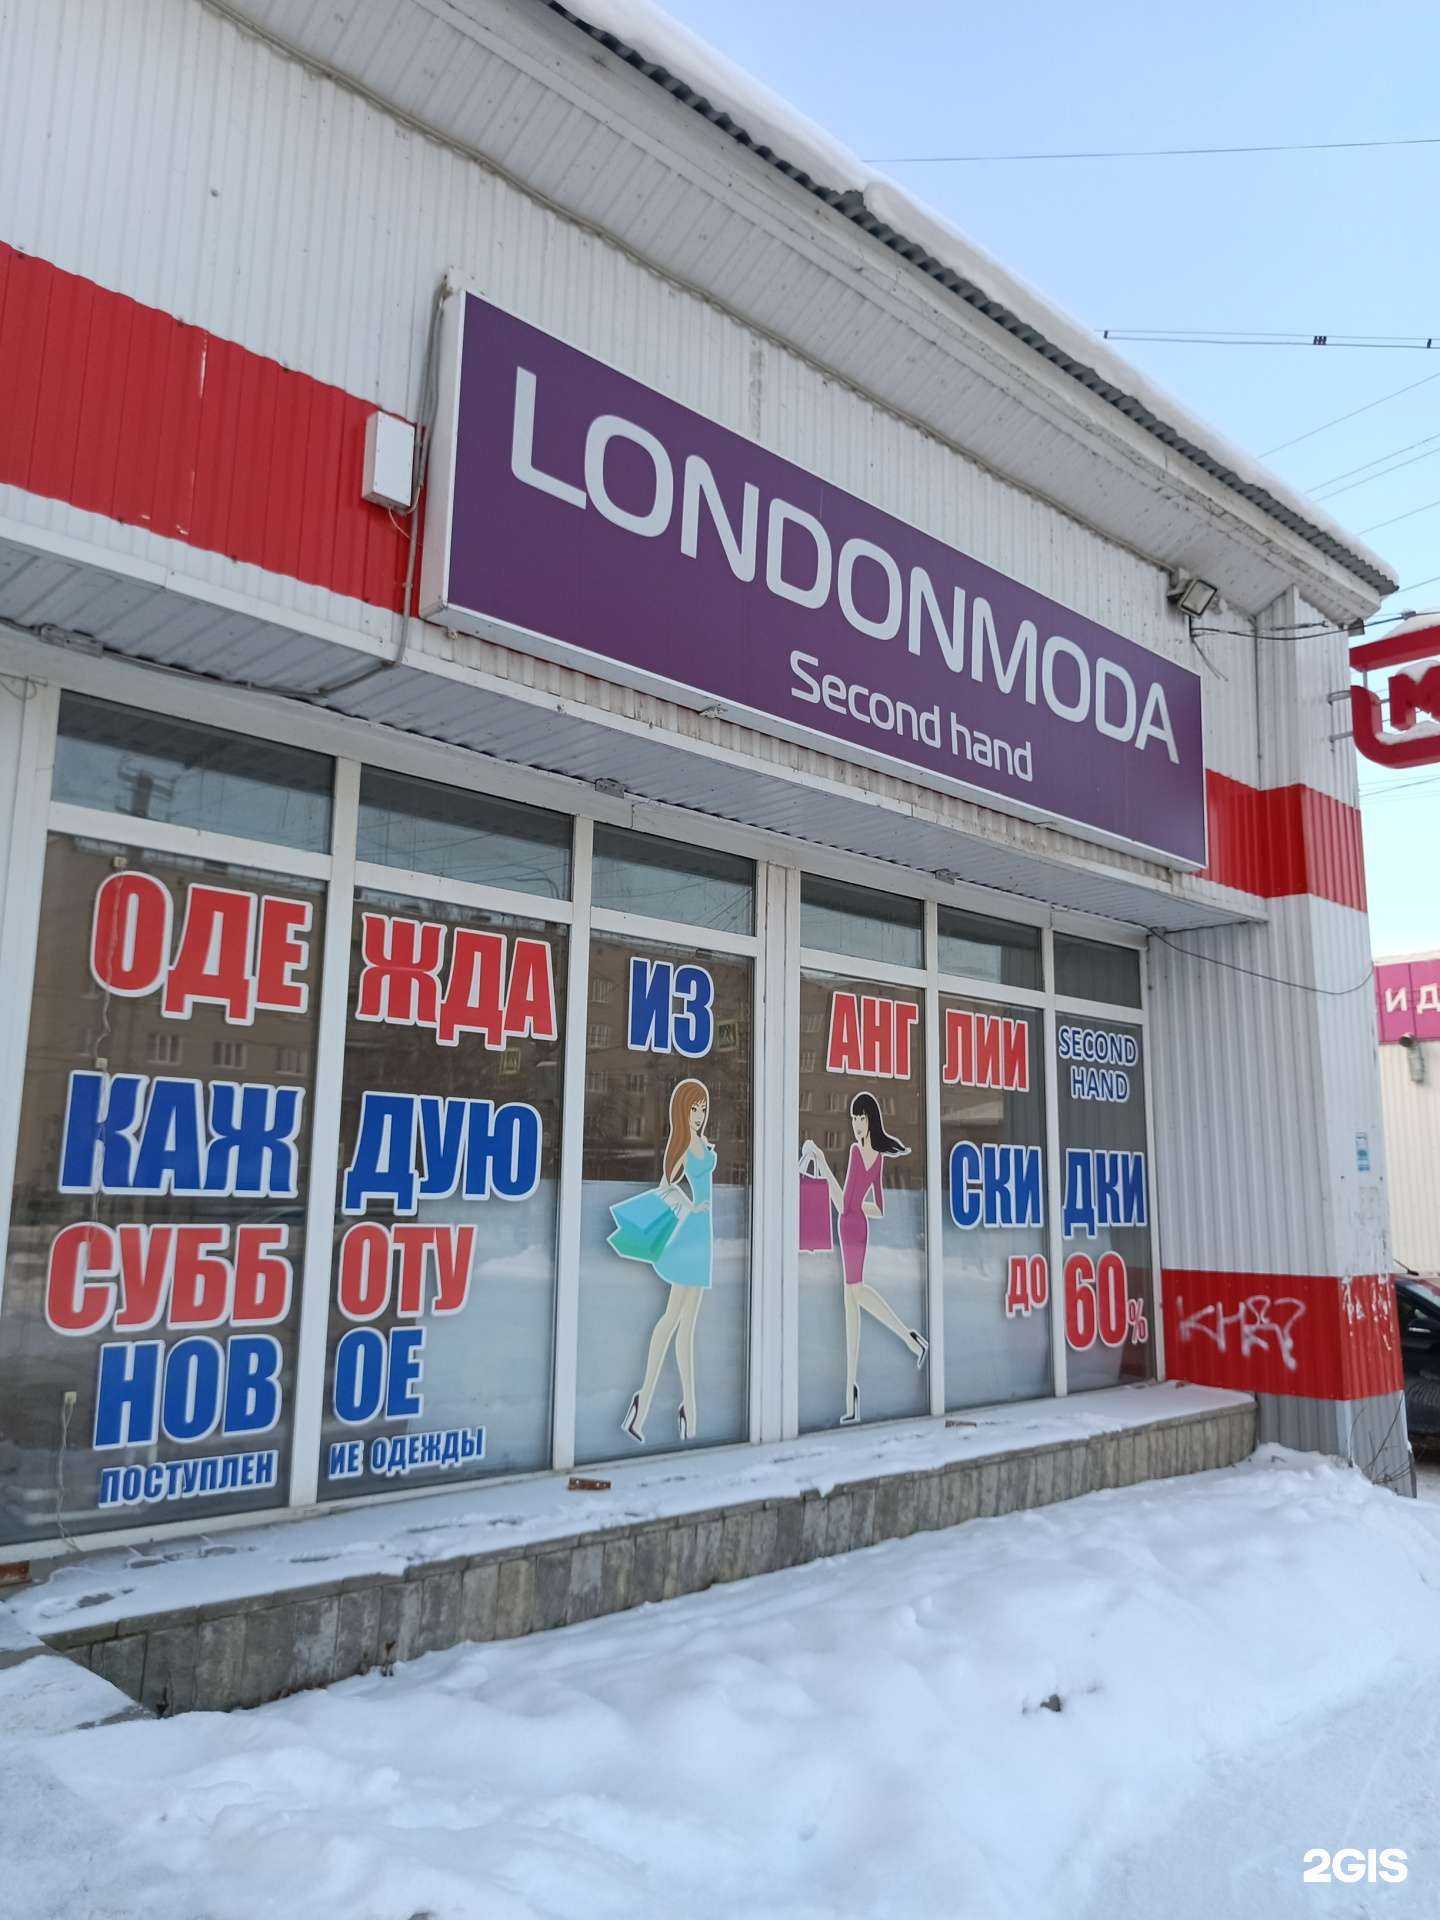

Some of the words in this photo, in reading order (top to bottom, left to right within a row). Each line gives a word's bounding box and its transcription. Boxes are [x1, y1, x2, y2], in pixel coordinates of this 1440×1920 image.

[510, 365, 1180, 767] LONDONMODA
[790, 649, 941, 748] Second
[951, 713, 1033, 783] hand
[628, 957, 714, 1058] ИЗ
[1059, 1026, 1137, 1066] SECOND
[1071, 1066, 1128, 1102] HAND
[370, 1426, 486, 1478] ОДЕЖДЫ
